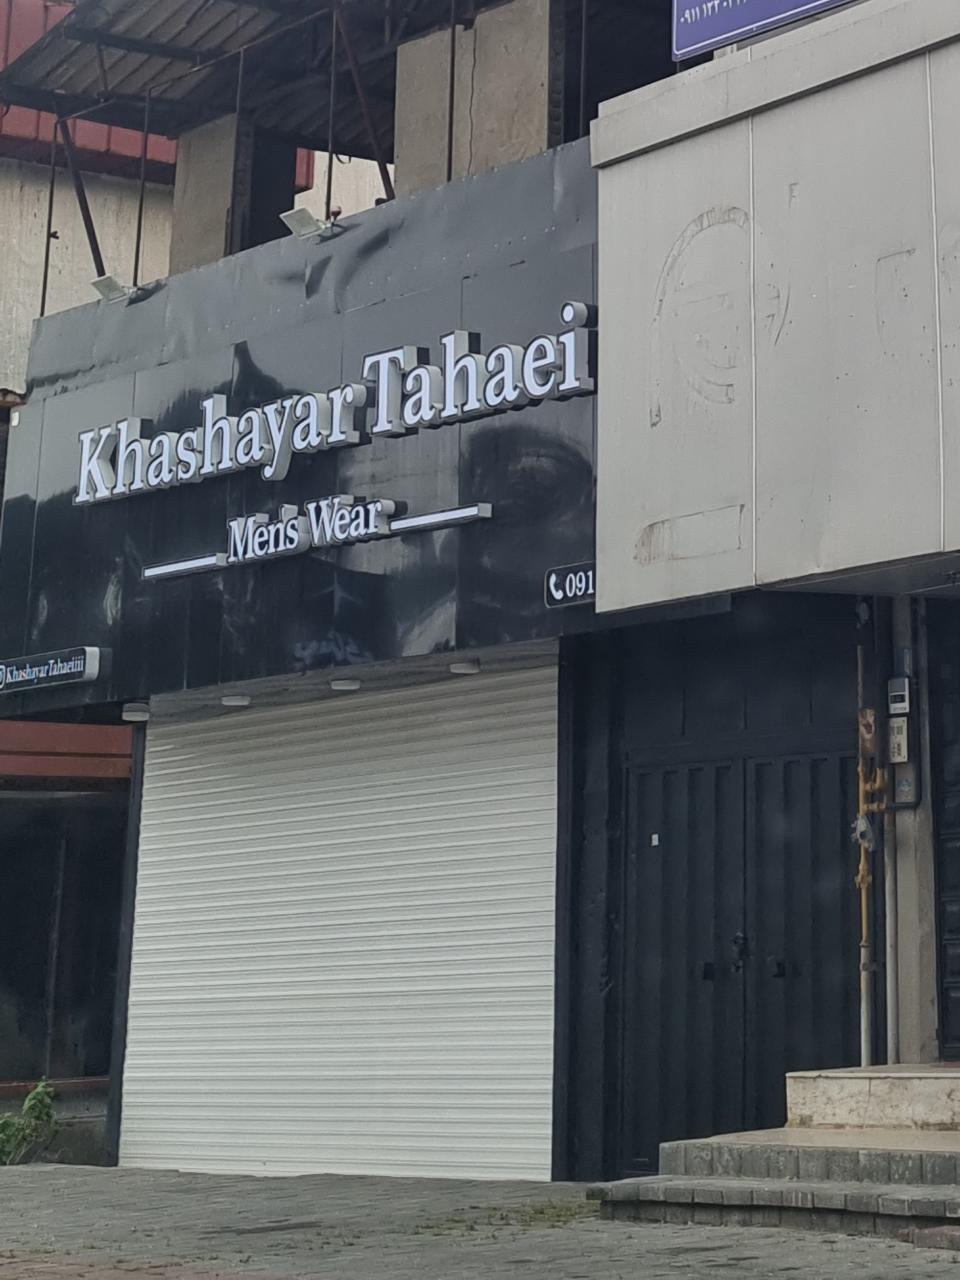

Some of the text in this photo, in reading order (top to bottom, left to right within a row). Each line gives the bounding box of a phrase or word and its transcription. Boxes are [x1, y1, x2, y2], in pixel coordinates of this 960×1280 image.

[74, 302, 594, 504] Khashayar Tahaei
[305, 496, 387, 547] Wear
